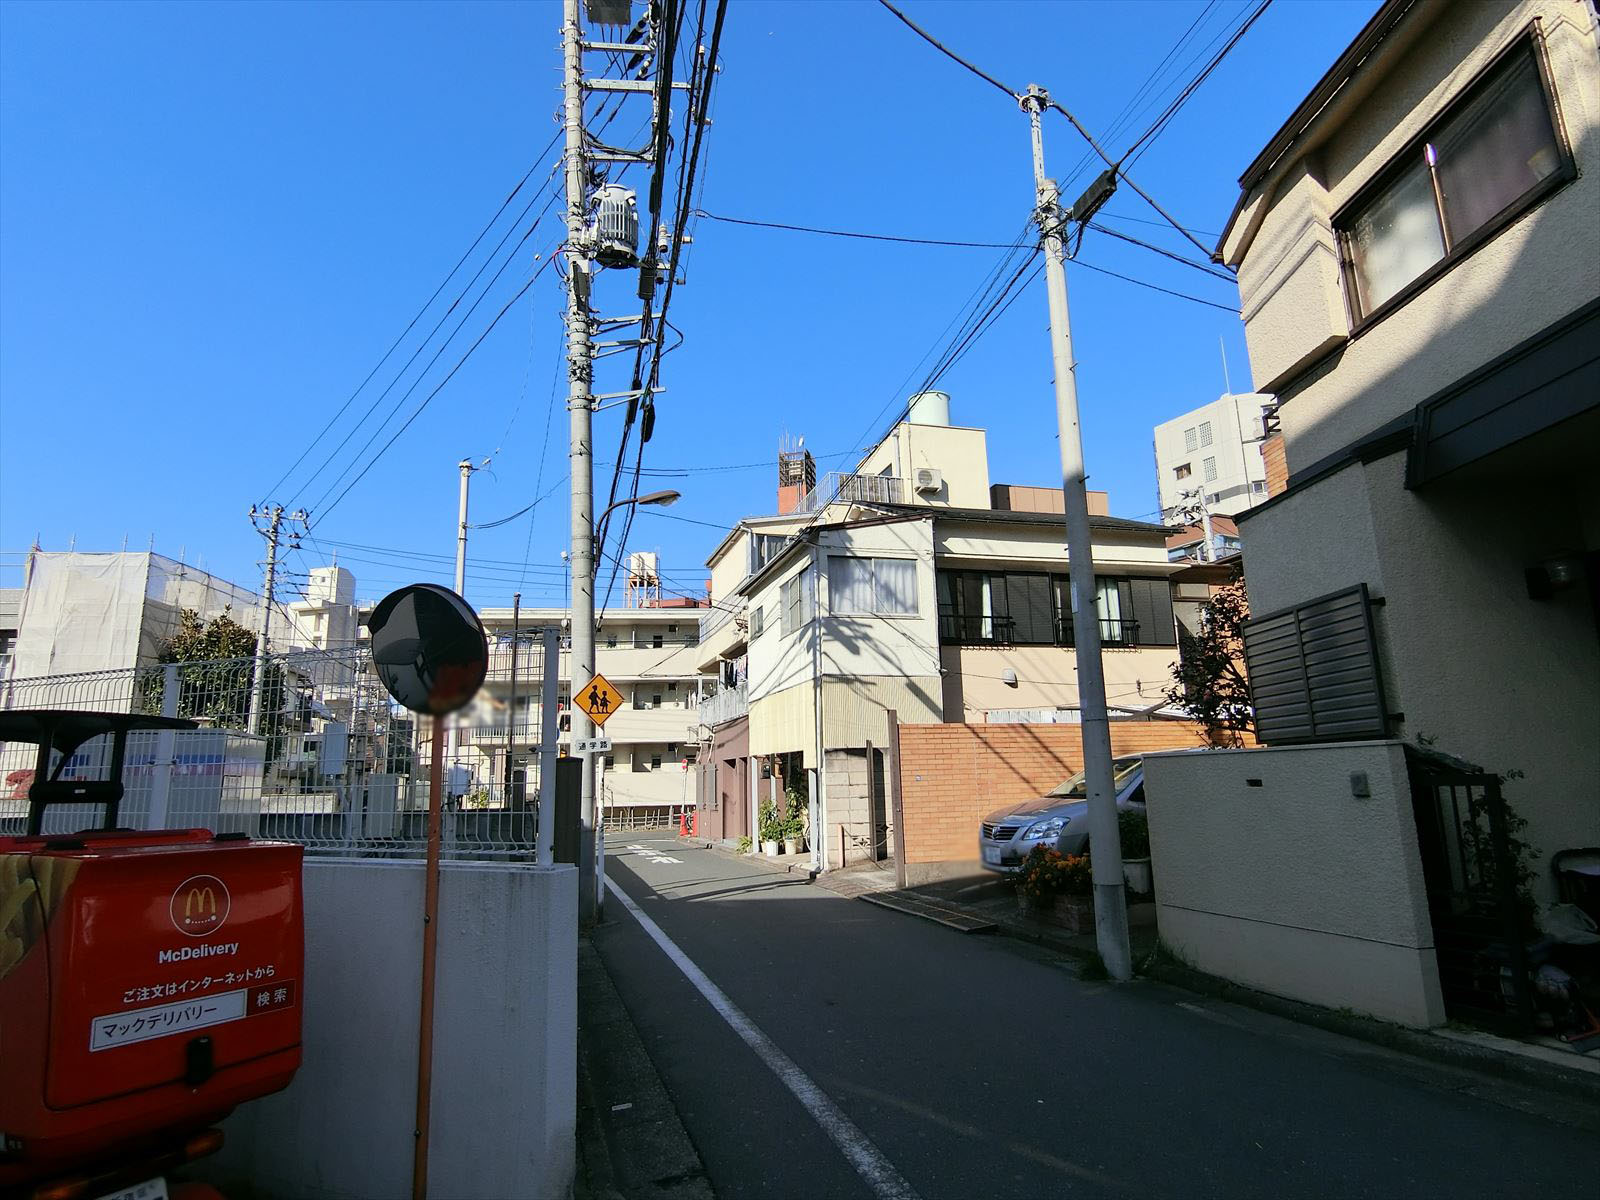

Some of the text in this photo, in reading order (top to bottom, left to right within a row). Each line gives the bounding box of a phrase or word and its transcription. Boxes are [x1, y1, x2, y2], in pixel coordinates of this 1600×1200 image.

[578, 741, 608, 750] 通学路
[159, 943, 239, 964] McDelivery
[123, 966, 275, 1004] ご注文はインターネットから
[257, 988, 287, 1007] 検索
[103, 1007, 217, 1038] マックデリバリー
